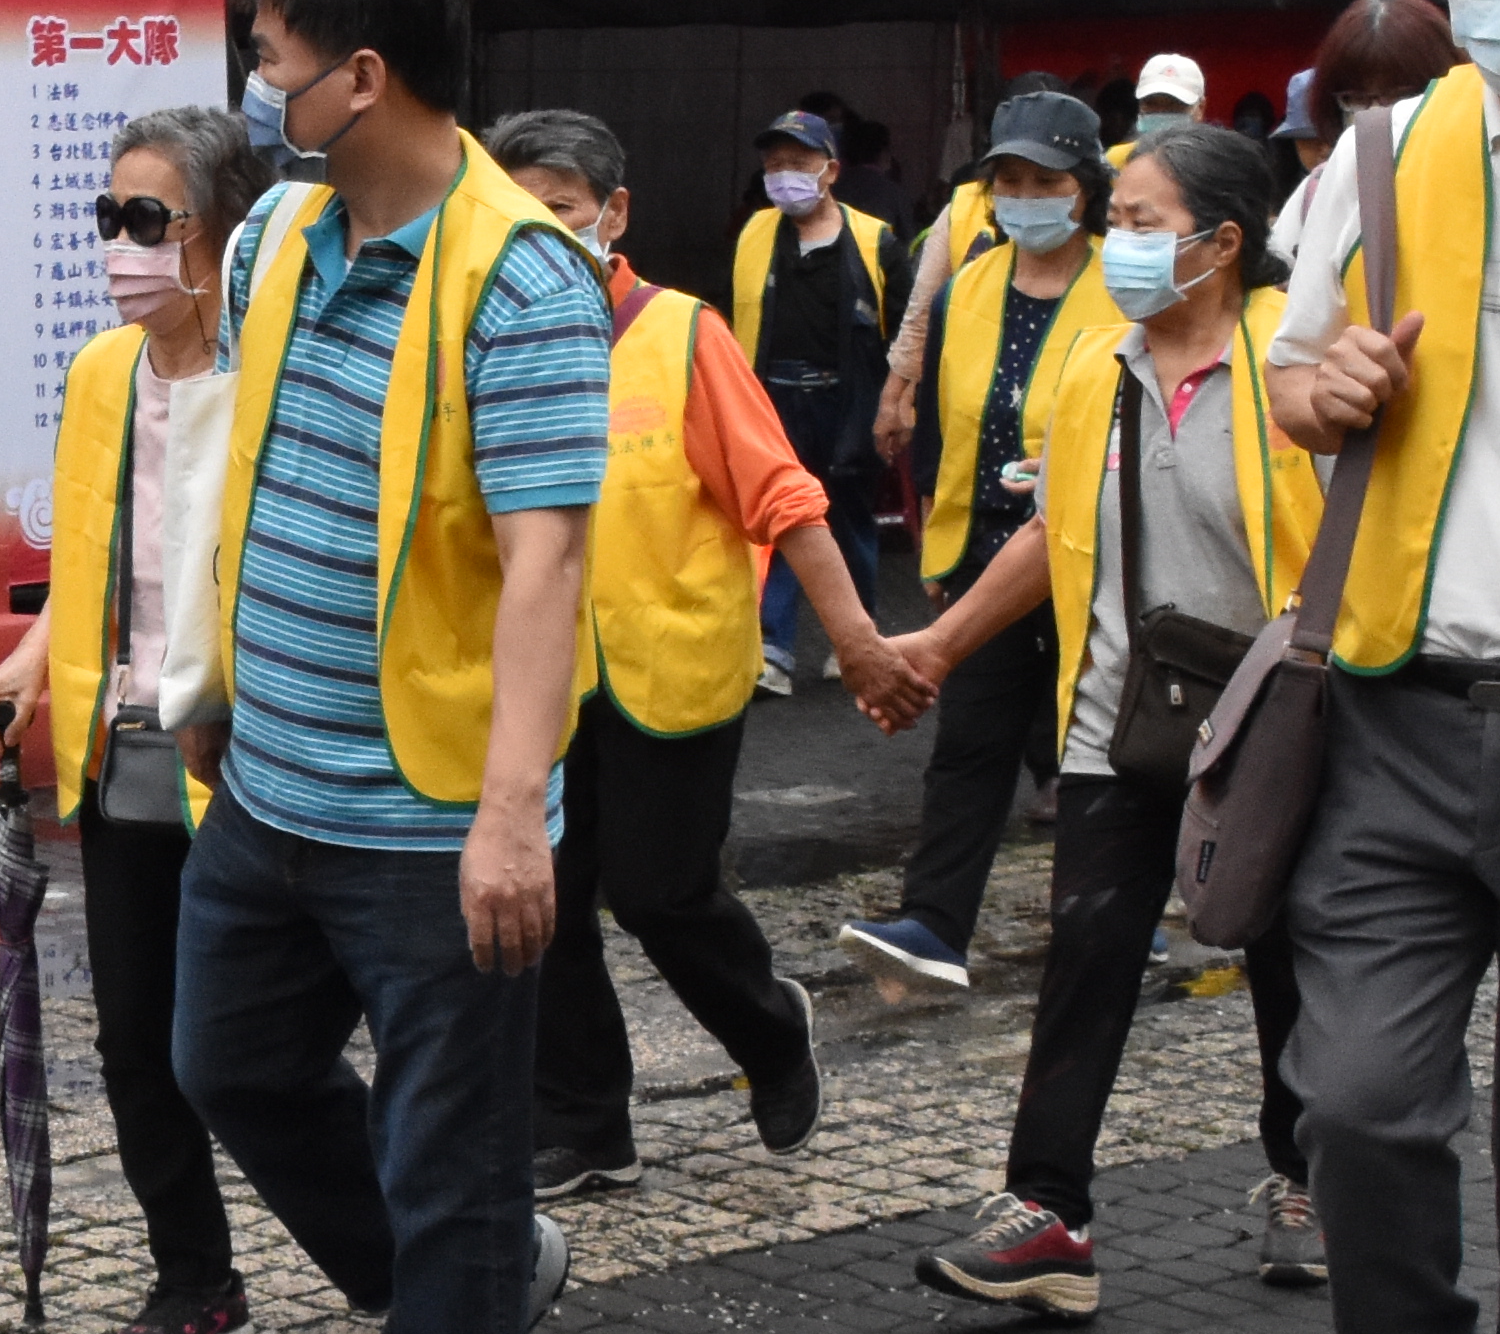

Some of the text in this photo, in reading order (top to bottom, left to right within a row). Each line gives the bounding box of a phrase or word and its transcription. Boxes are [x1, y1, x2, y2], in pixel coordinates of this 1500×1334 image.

[28, 17, 181, 68] 第一大隊
[32, 83, 79, 101] 1 法師
[31, 114, 39, 128] 2
[33, 144, 40, 159] 3
[31, 173, 40, 189] 4
[33, 203, 41, 219] 5
[33, 233, 42, 249] 6
[34, 260, 106, 281] 7 龜山覺
[34, 292, 44, 309] 8
[34, 323, 44, 338] 9
[33, 353, 48, 368] 10
[36, 383, 45, 398] 11
[35, 413, 48, 428] 12
